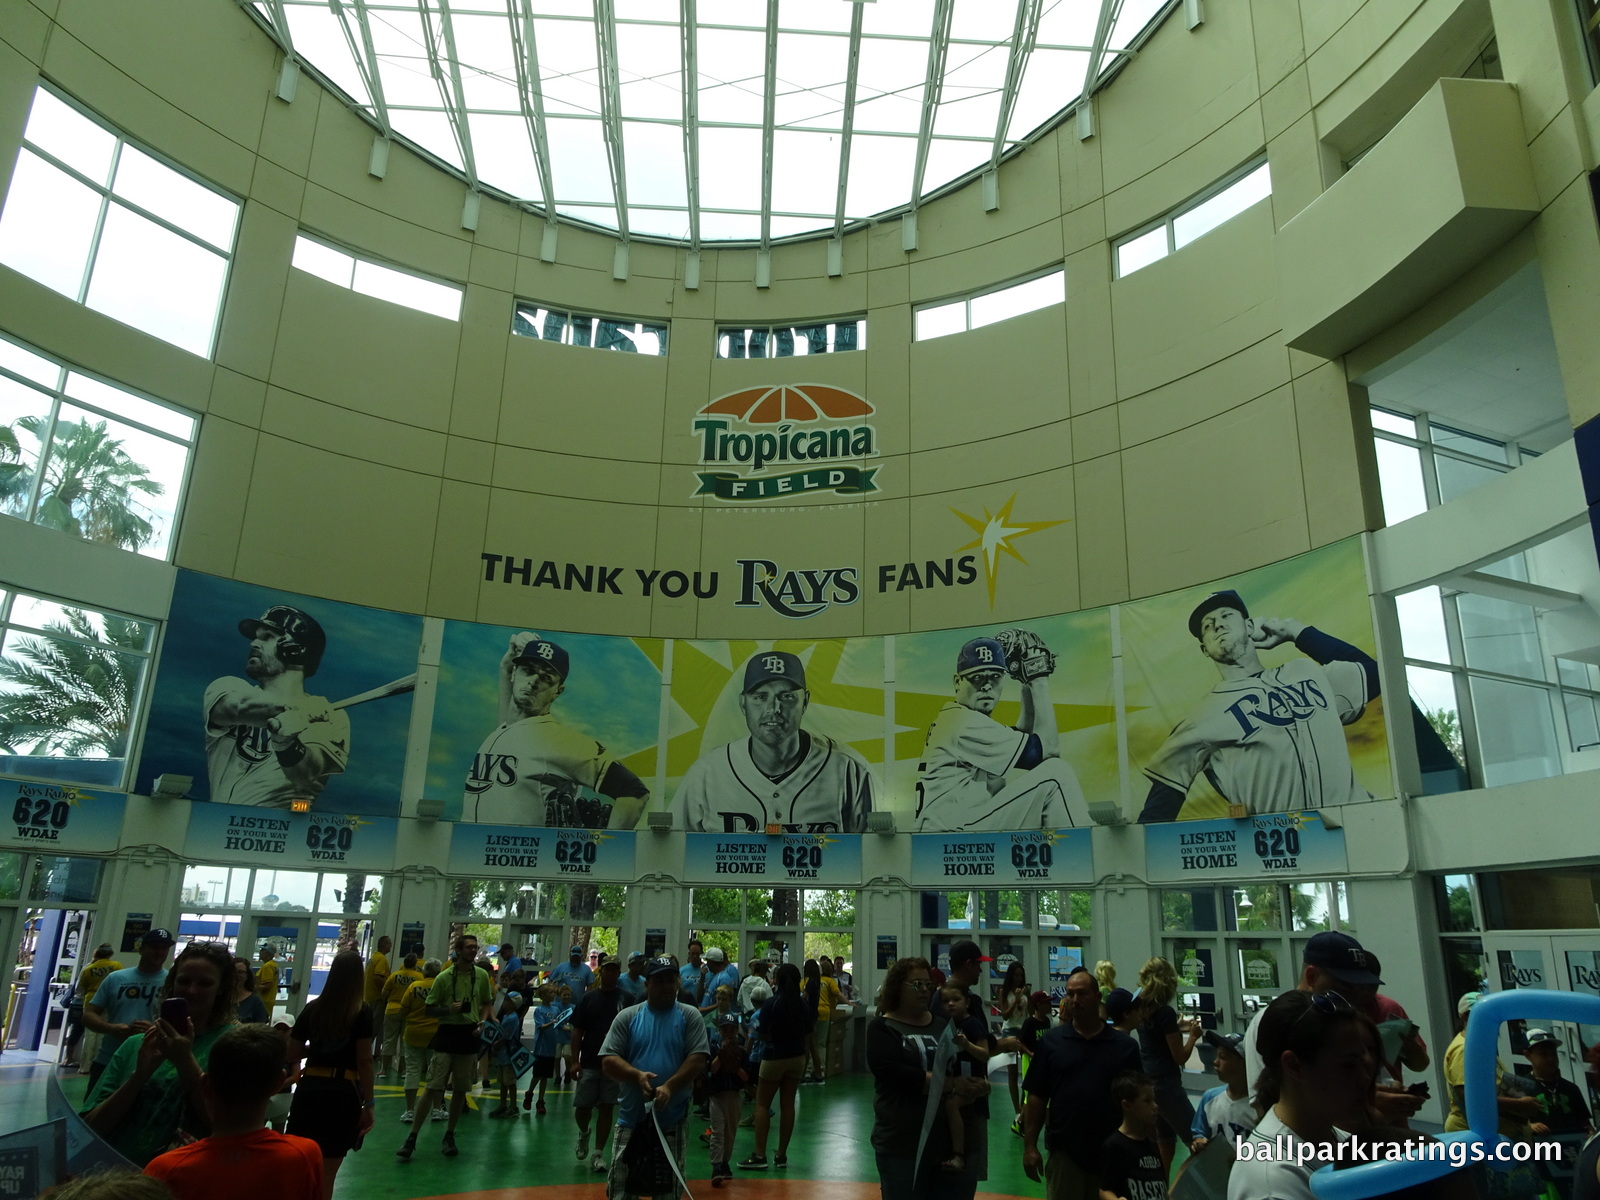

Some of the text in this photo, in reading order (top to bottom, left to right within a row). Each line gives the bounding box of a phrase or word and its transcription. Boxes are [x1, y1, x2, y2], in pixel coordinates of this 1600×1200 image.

[693, 418, 873, 470] Tropicana
[731, 471, 846, 497] FIELD
[480, 552, 624, 596] THANK
[635, 567, 719, 601] YOU
[878, 554, 979, 595] FANS
[536, 640, 555, 661] TB
[974, 645, 994, 664] TB
[761, 655, 786, 675] TB
[1223, 678, 1329, 743] RAYS
[44, 788, 77, 801] RADIO
[12, 796, 71, 830] 620
[228, 815, 292, 831] LISTEN
[331, 816, 358, 827] RADIO
[1273, 816, 1300, 828] RADIO
[17, 826, 60, 840] WDAE
[226, 828, 289, 840] ON YOUR WAY
[306, 824, 353, 851] 620
[486, 834, 541, 847] LISTEN
[576, 831, 600, 842] RADIO
[1029, 833, 1054, 843] RADIO
[1179, 830, 1236, 845] LISTEN
[224, 836, 286, 854] HOME
[716, 843, 768, 854] LISTEN
[801, 836, 825, 847] RADIO
[943, 842, 996, 854] LISTEN
[1194, 846, 1217, 854] YOUR
[1219, 844, 1237, 852] WAY
[1253, 827, 1301, 858] 620
[310, 850, 346, 861] WDAE
[555, 840, 597, 865] 620
[782, 846, 823, 868] 620
[1011, 843, 1054, 869] 620
[484, 853, 538, 868] HOME
[559, 863, 591, 873] WDAE
[715, 861, 766, 874] HOME
[1181, 853, 1238, 870] HOME
[1262, 857, 1297, 869] WDAE
[787, 869, 818, 878] WDAE
[943, 862, 995, 876] HOME
[1017, 868, 1049, 878] WDAE
[1503, 962, 1543, 987] RAYS
[1572, 964, 1600, 990] RA
